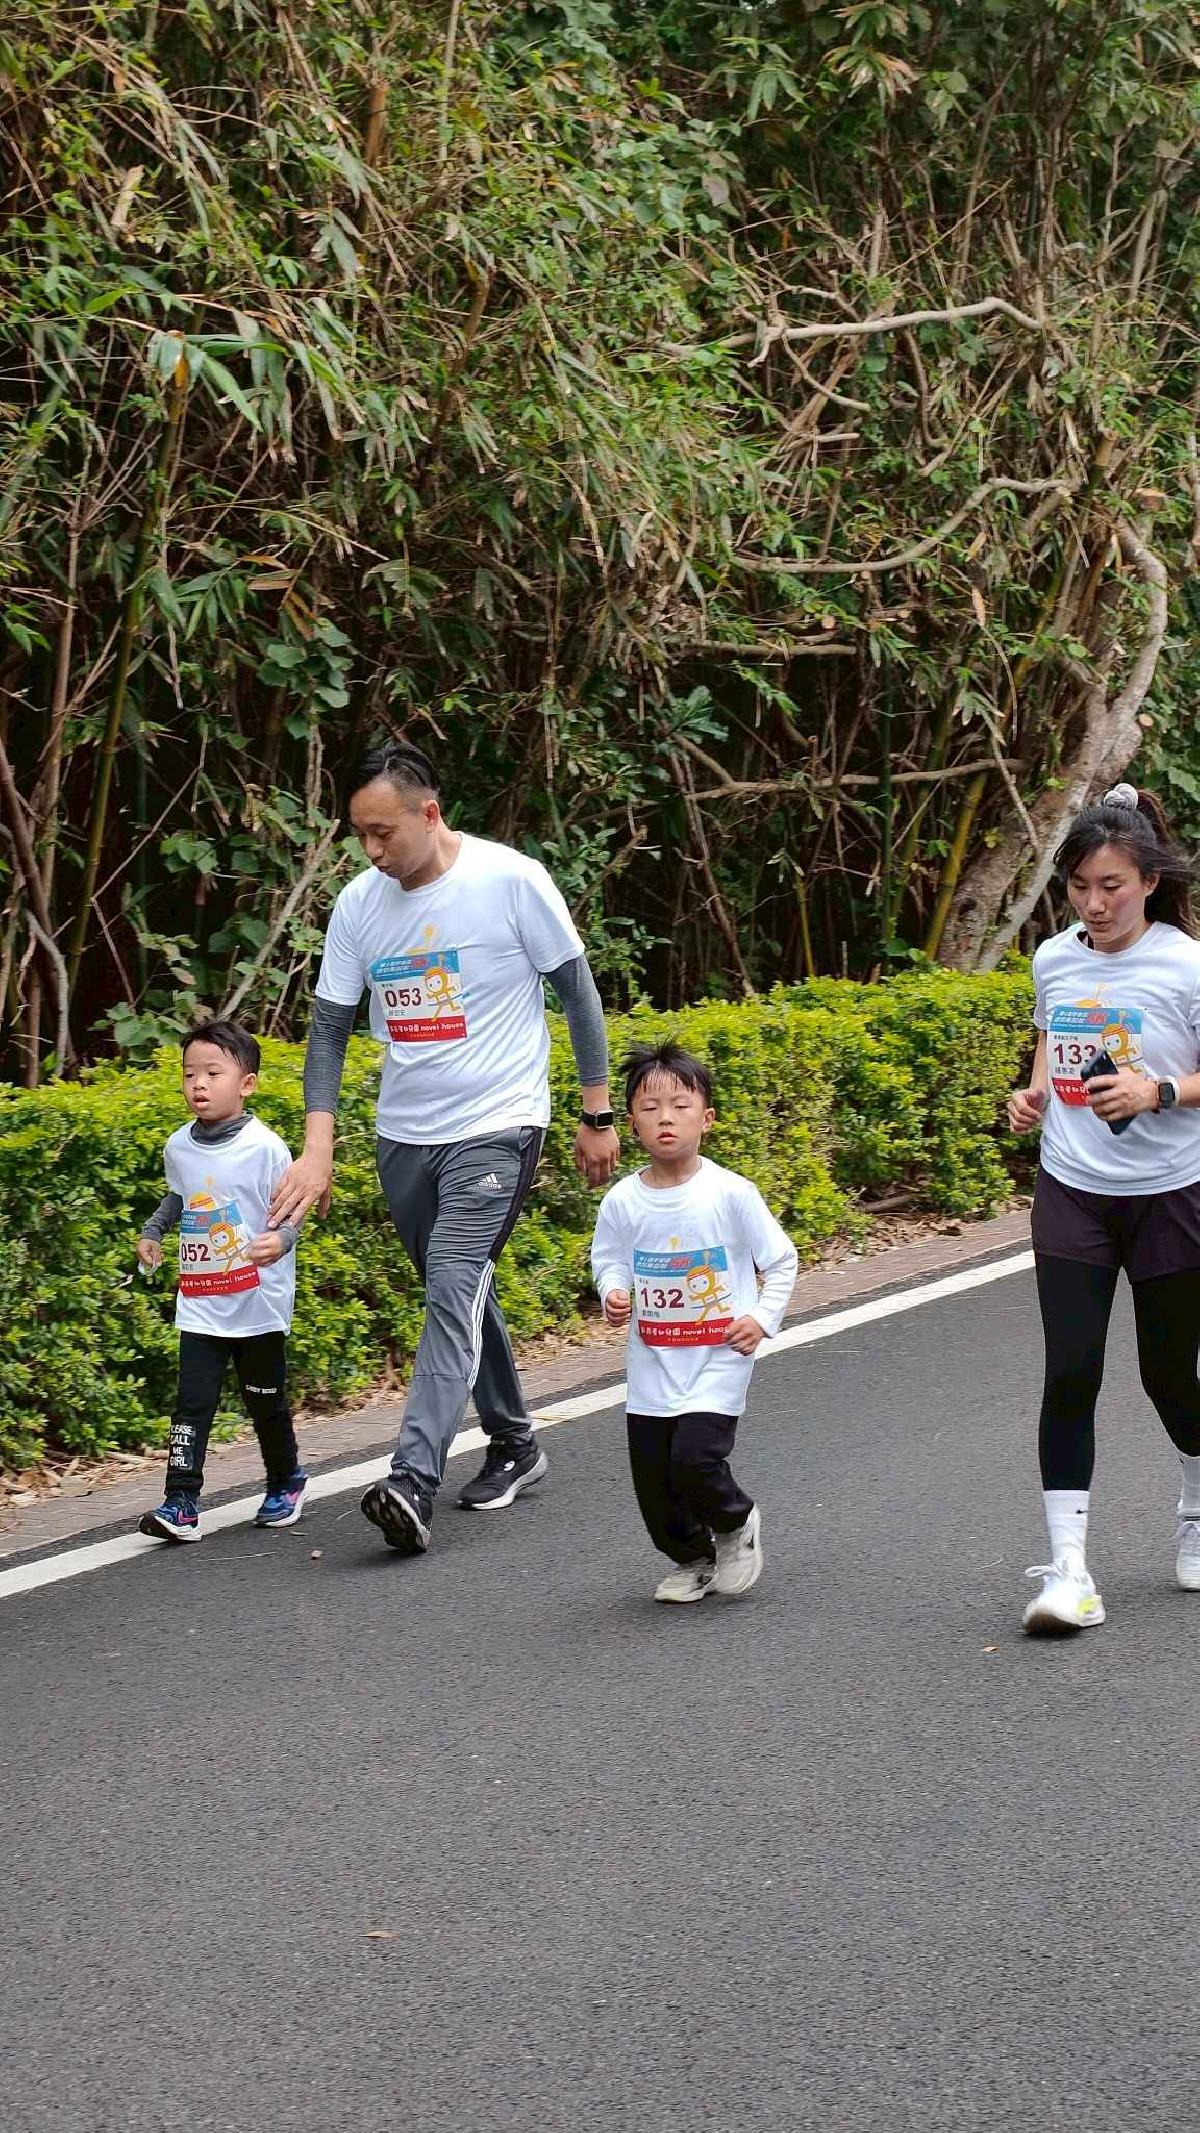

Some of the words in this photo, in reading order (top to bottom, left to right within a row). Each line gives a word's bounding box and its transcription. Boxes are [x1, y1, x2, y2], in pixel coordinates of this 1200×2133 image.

[384, 987, 422, 1008] 053
[181, 1243, 211, 1262] 052
[213, 1276, 232, 1285] novel
[640, 1287, 685, 1309] 132
[682, 1328, 706, 1336] novel
[172, 1446, 184, 1455] ME
